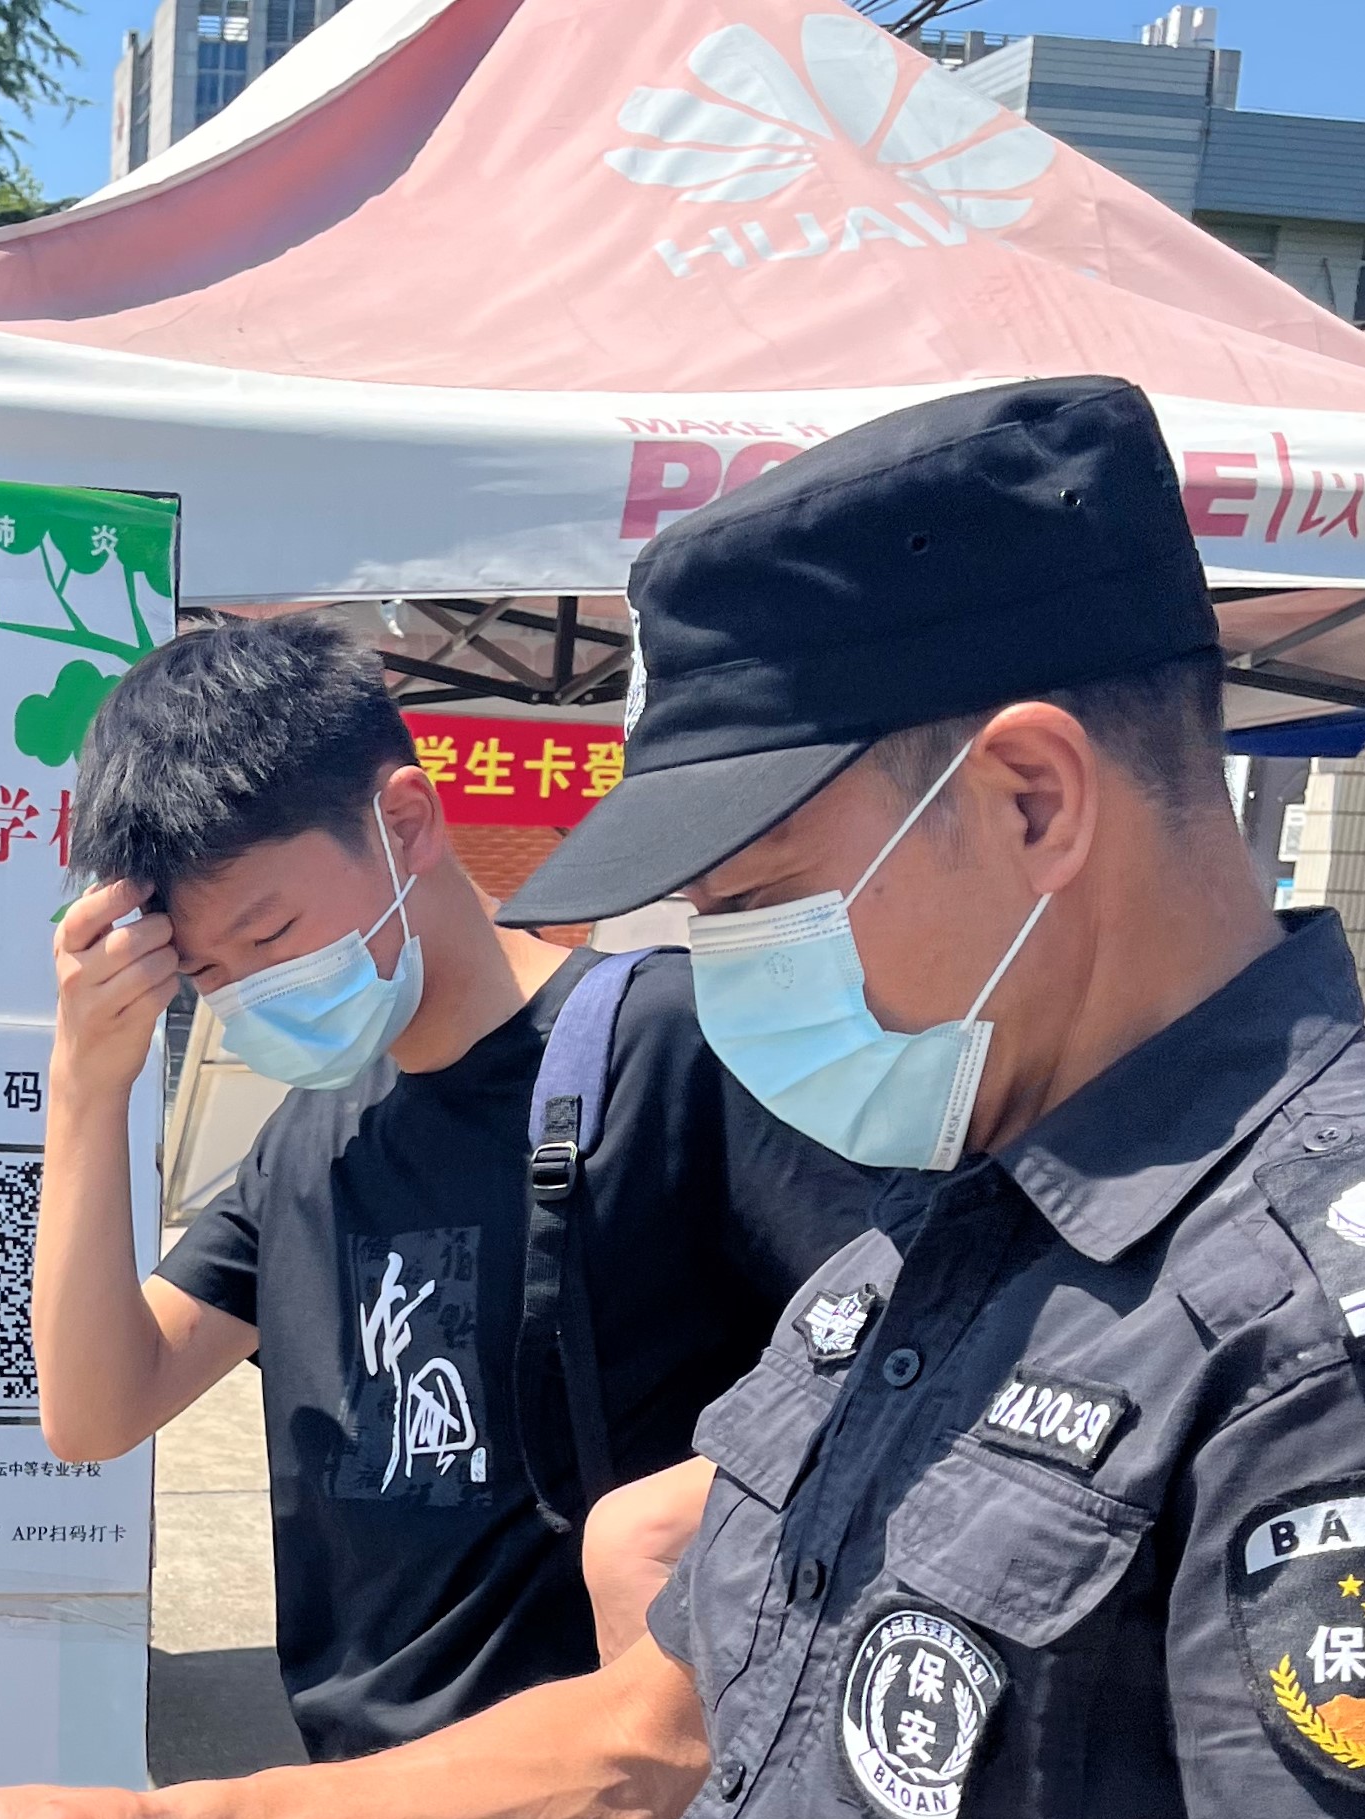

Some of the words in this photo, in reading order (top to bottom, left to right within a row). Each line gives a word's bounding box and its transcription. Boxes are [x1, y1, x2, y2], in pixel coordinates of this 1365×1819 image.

[617, 416, 783, 437] MAKE
[415, 736, 624, 798] 学生卡登
[988, 1382, 1111, 1454] BA2039
[873, 1763, 947, 1812] BAOAN
